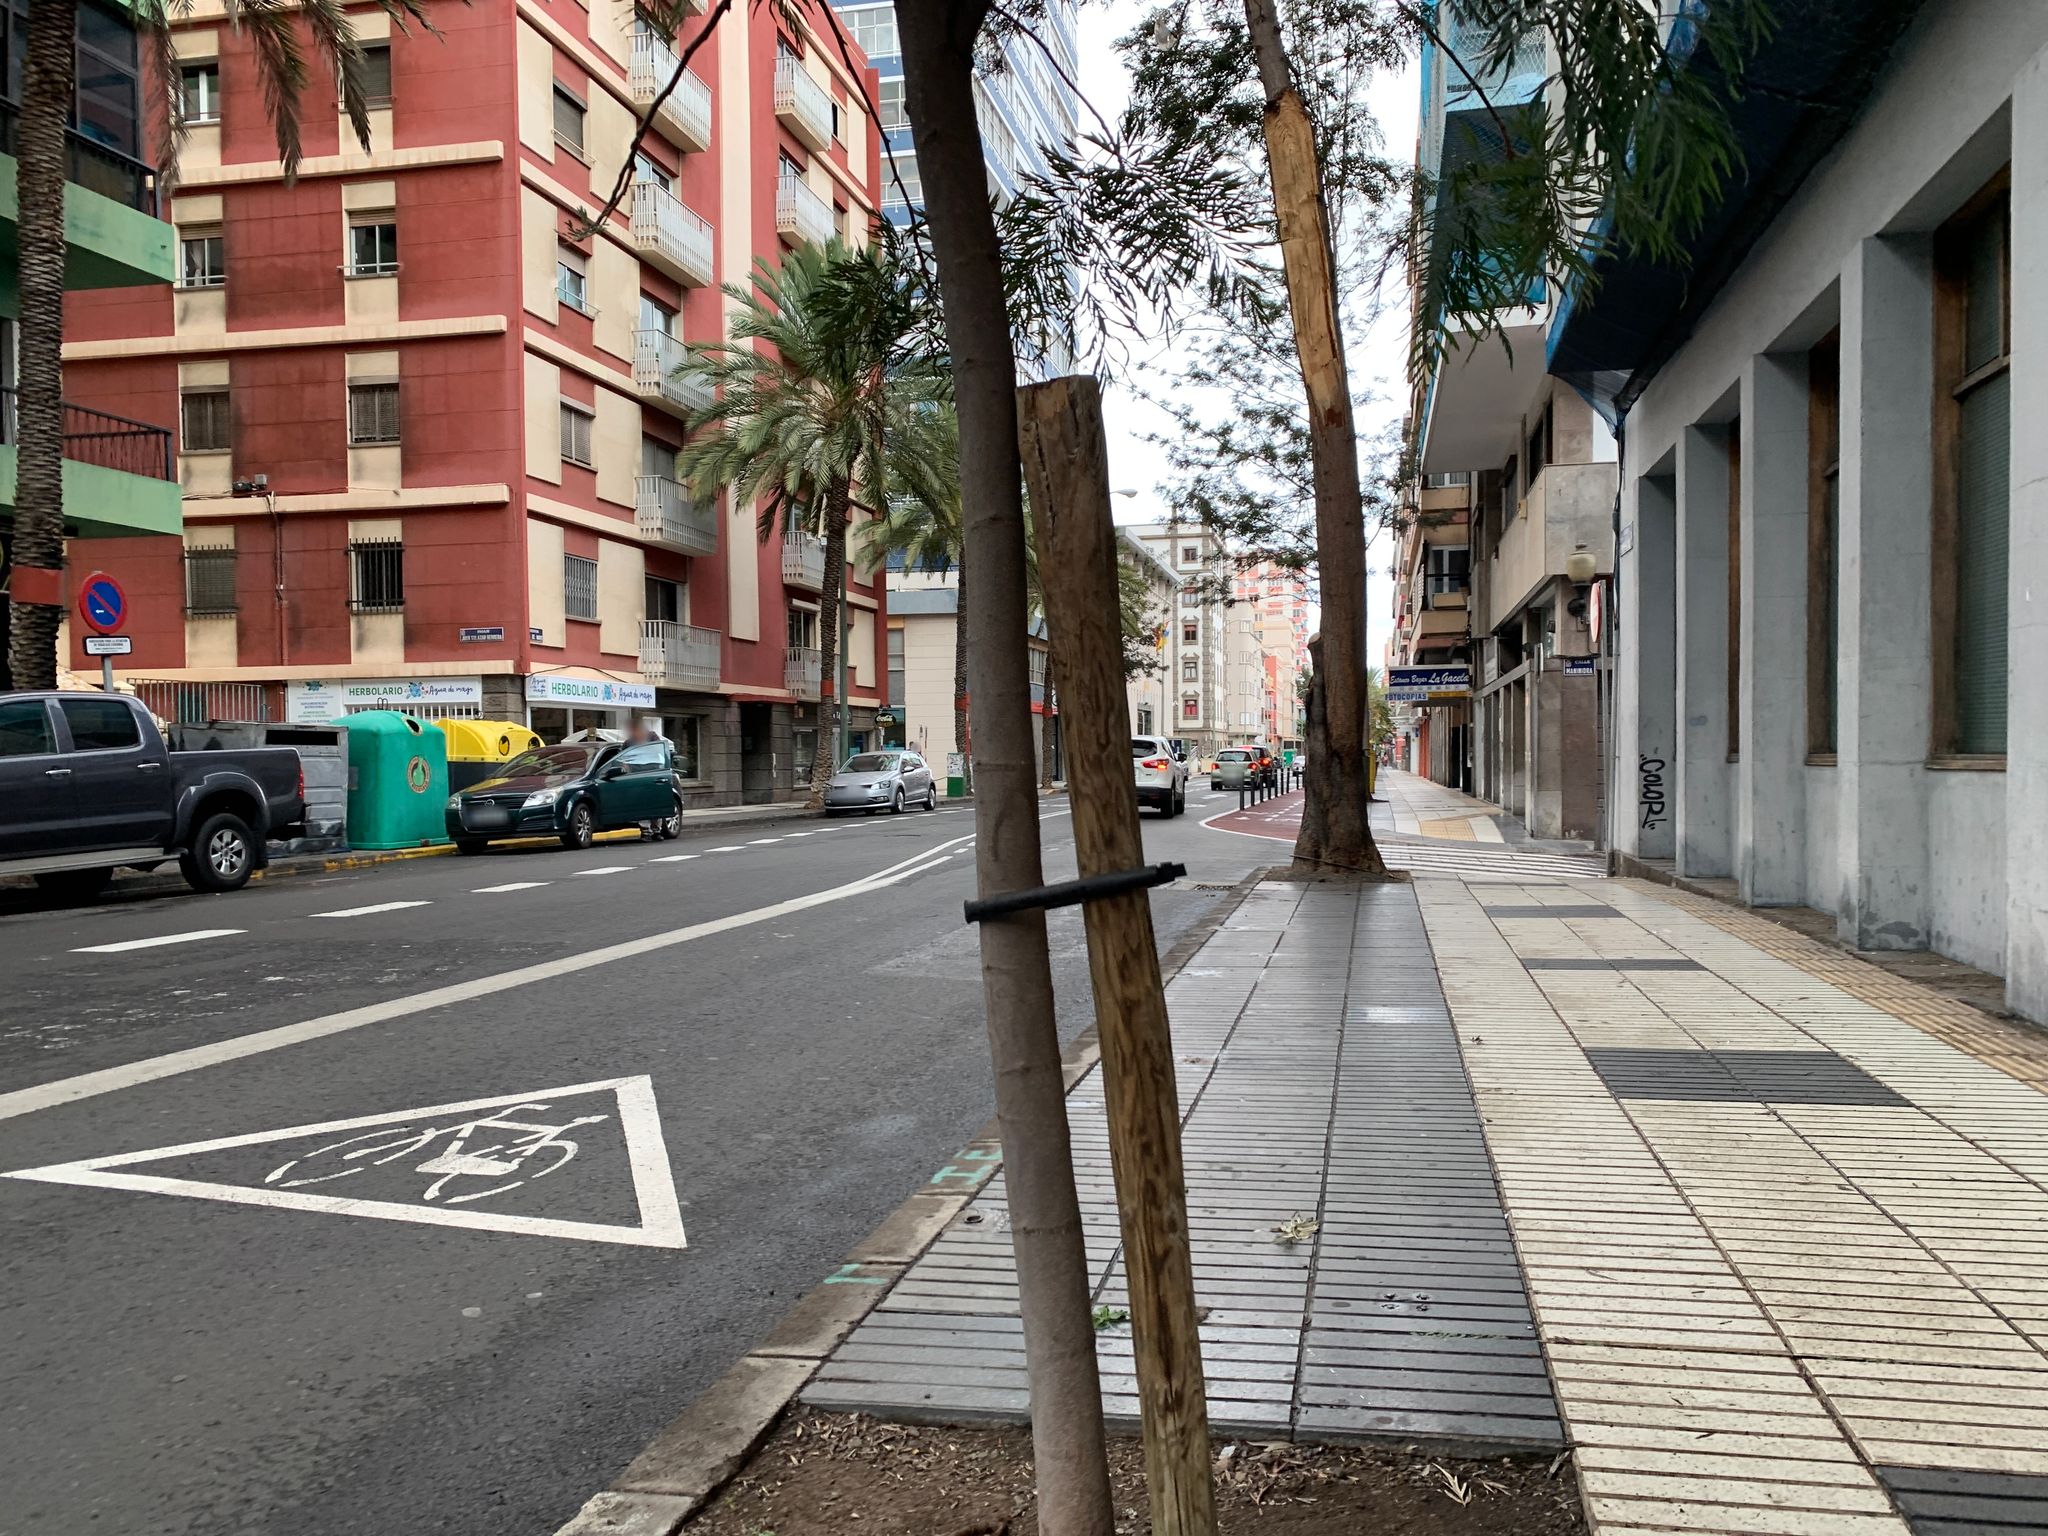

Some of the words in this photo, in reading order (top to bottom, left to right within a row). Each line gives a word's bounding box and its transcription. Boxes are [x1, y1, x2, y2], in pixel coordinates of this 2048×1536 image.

[1428, 672, 1441, 683] La
[1441, 671, 1470, 684] Gacela
[349, 686, 403, 696] HERBOLARIO
[429, 685, 447, 696] Agua
[551, 682, 599, 698] HERBOLARIO
[618, 687, 633, 702] Agua
[1384, 692, 1427, 701] FOTOCOPIAS
